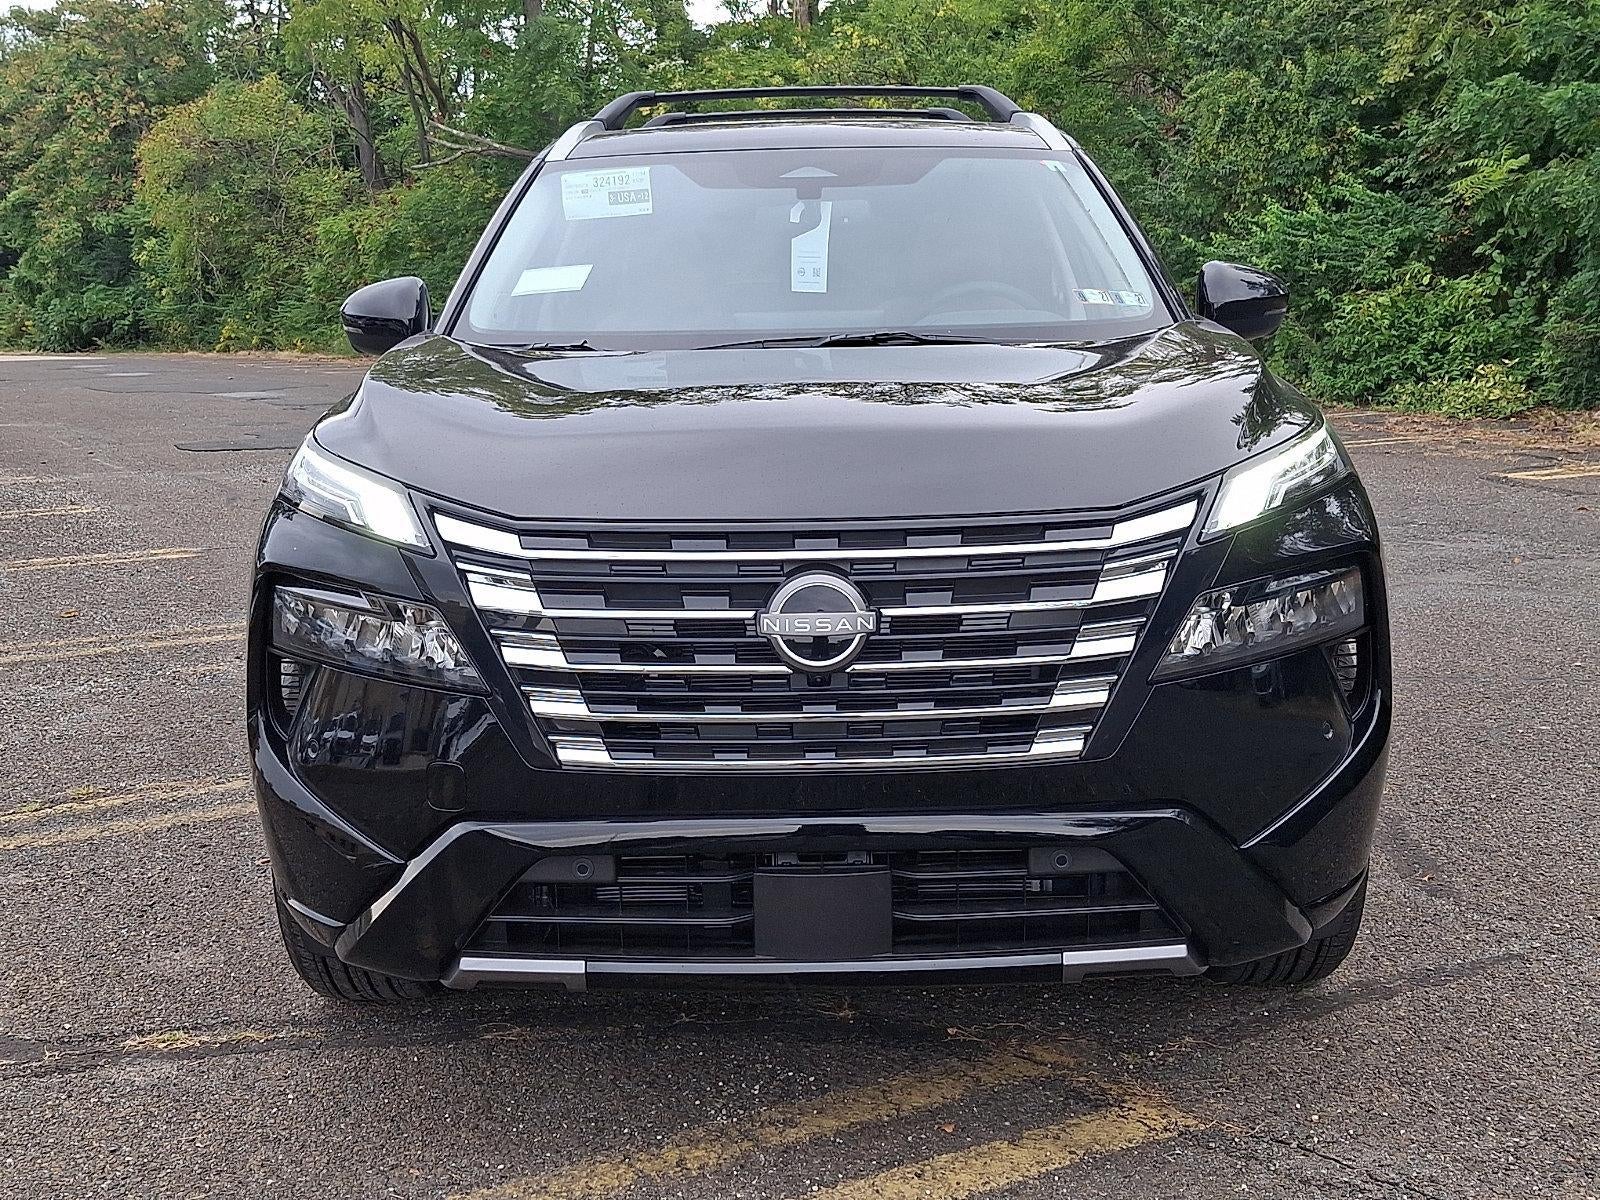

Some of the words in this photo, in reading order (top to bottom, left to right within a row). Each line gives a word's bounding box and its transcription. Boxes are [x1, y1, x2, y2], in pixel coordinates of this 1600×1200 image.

[592, 174, 630, 187] 324192
[617, 191, 637, 203] USA
[763, 616, 874, 632] NISSAN
